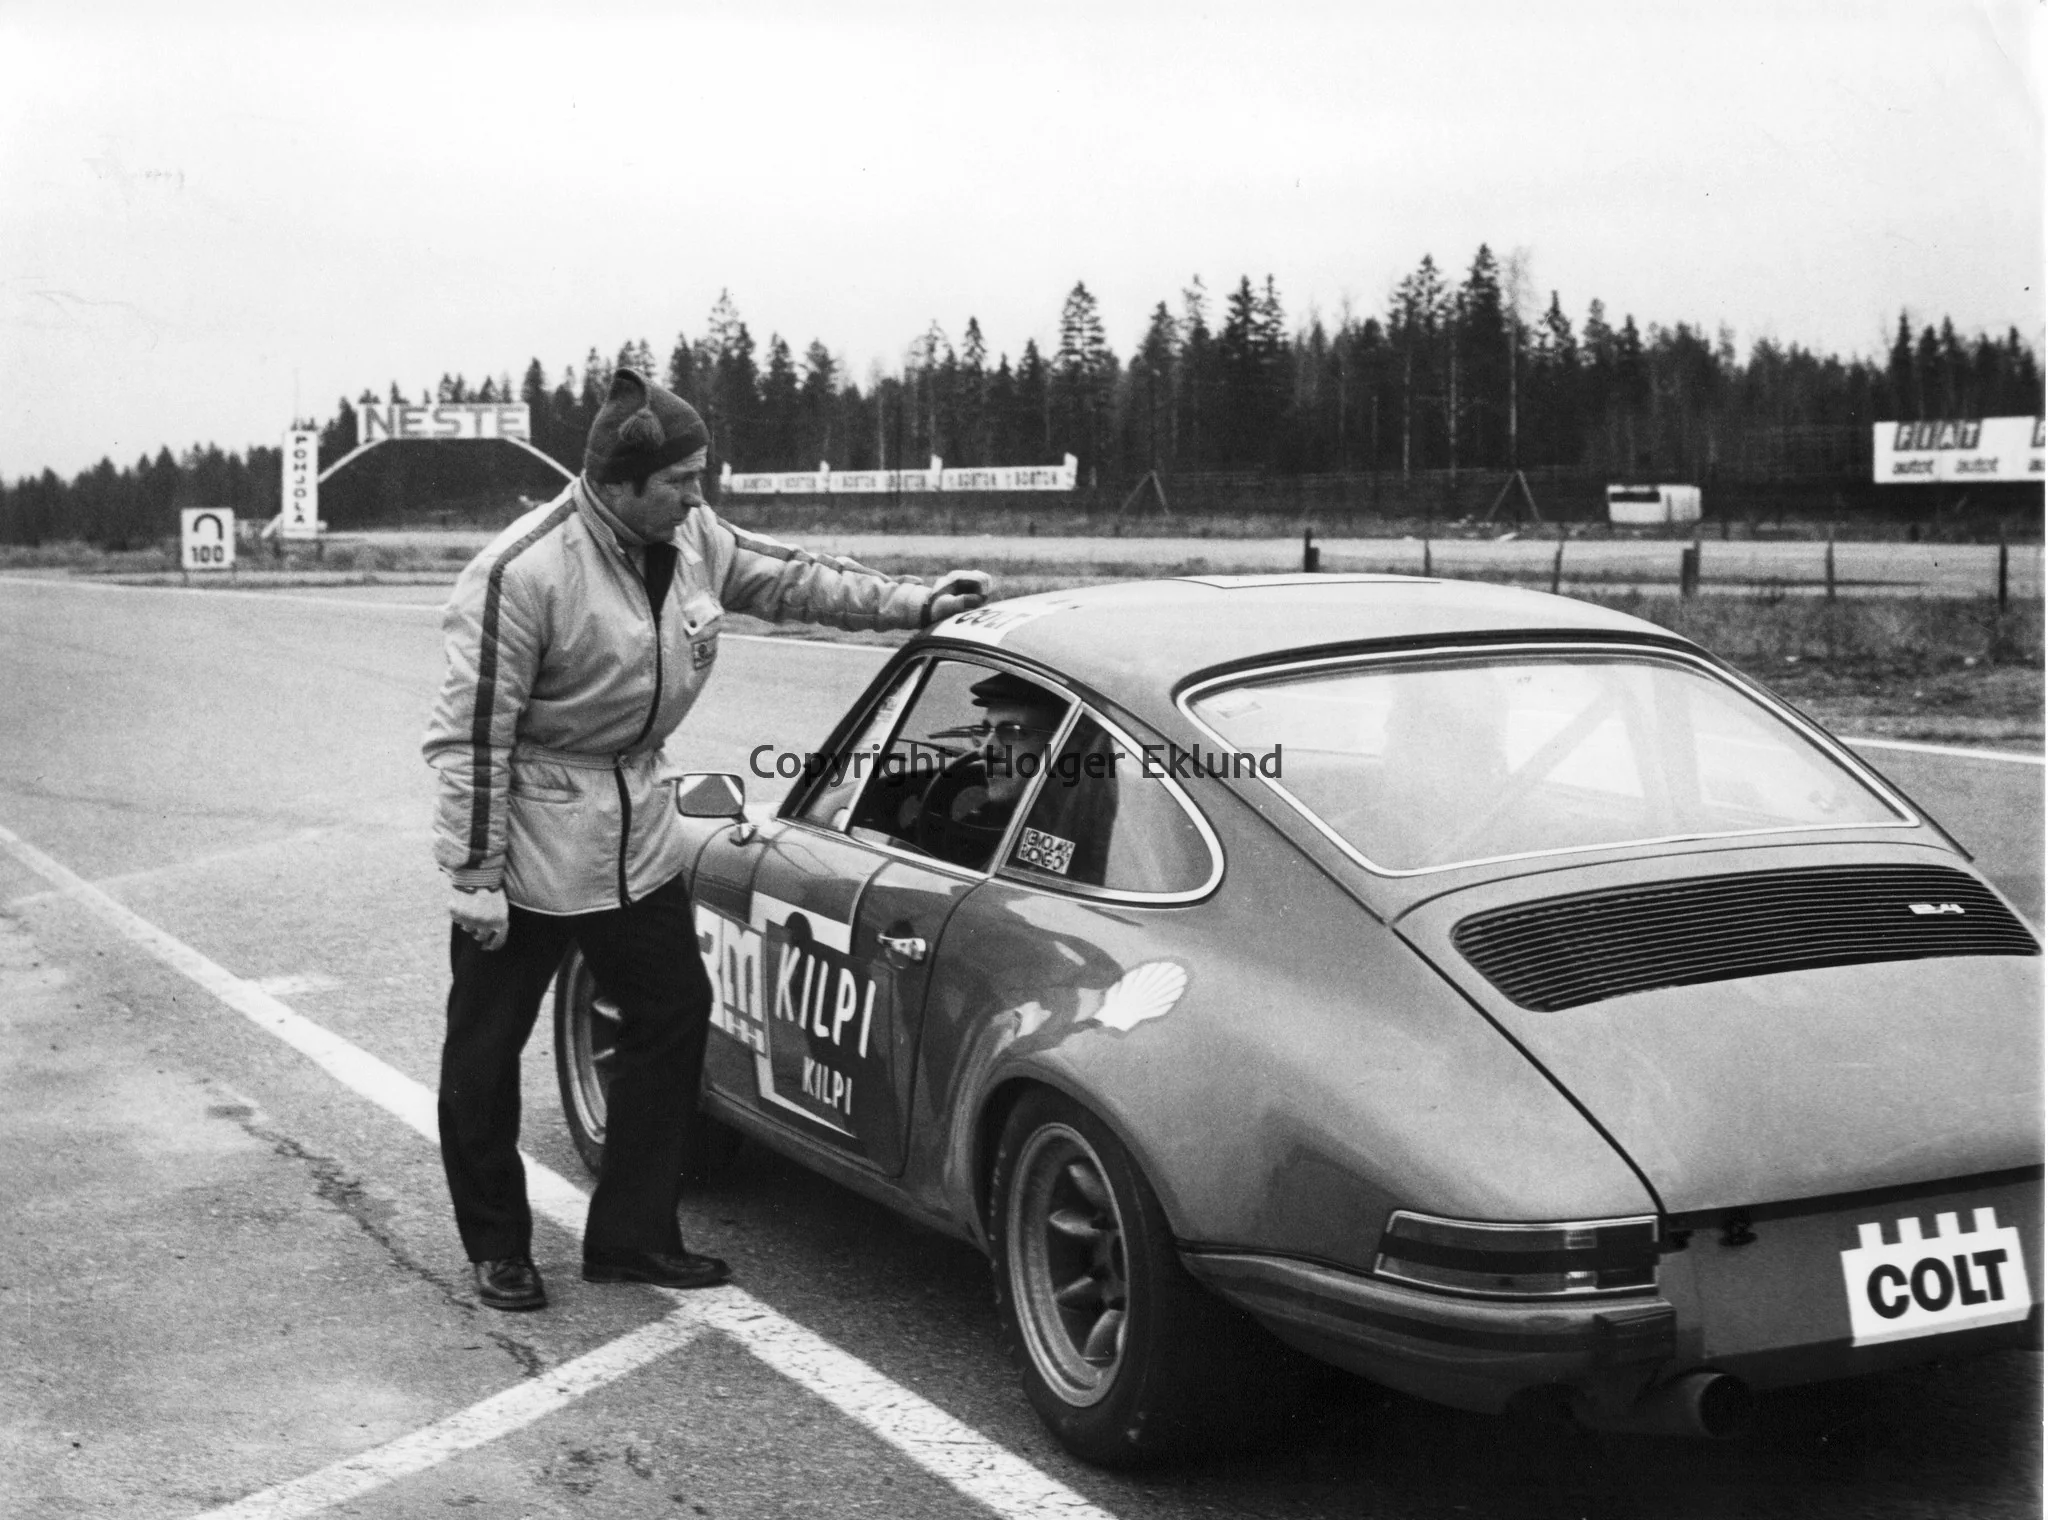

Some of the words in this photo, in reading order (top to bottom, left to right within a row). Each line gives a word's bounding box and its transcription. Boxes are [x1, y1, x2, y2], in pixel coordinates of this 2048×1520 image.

[363, 406, 527, 438] NESTE
[1895, 420, 1980, 450] FIAT
[292, 435, 309, 524] POHJOLA
[190, 544, 225, 563] 100
[775, 942, 877, 1059] KILPI
[802, 1055, 853, 1116] KILPI
[1866, 1248, 2009, 1320] COLT
